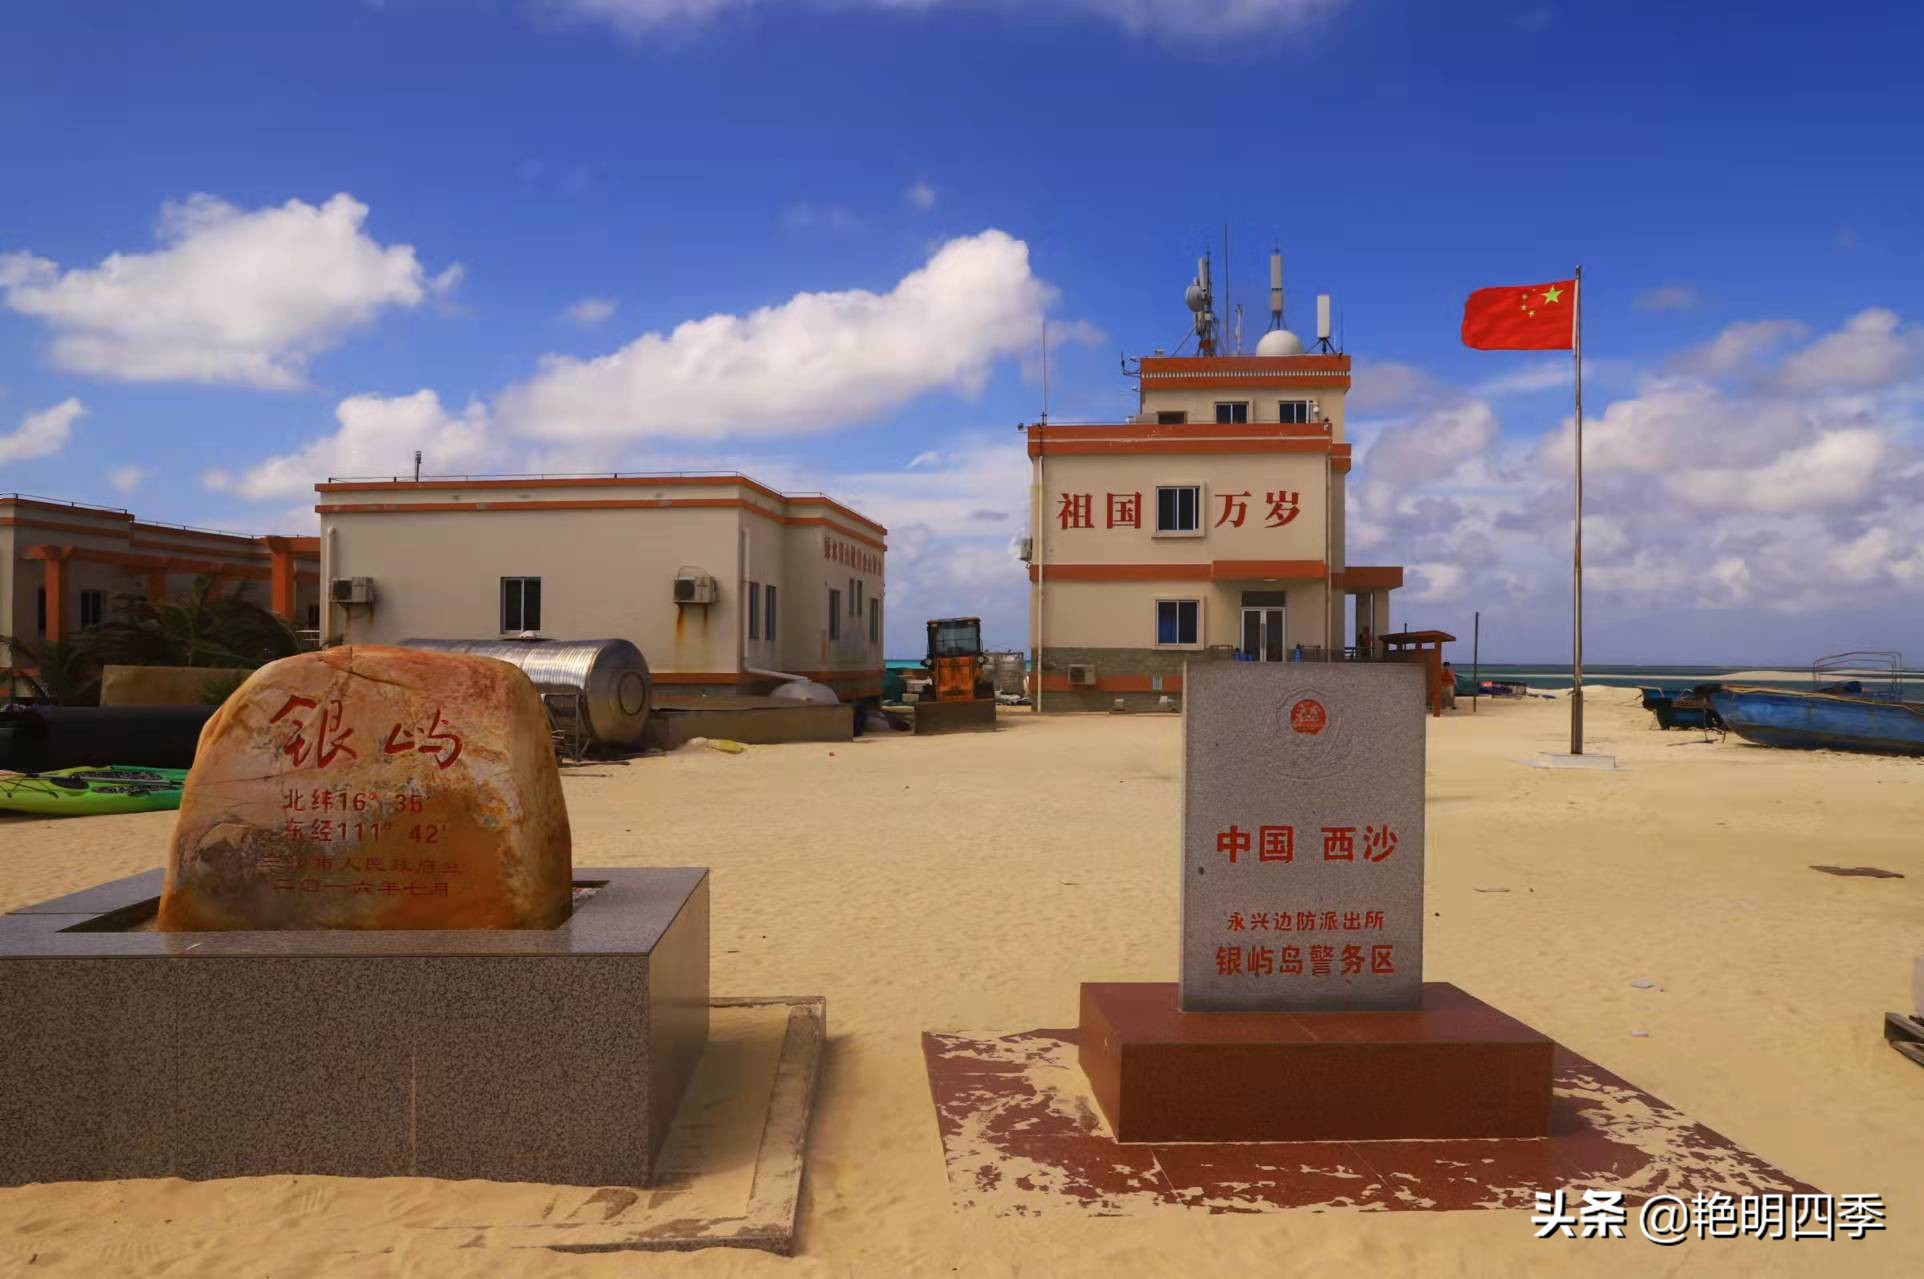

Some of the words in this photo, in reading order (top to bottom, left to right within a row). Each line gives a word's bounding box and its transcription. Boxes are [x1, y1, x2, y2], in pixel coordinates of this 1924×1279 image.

[1056, 491, 1142, 530] 祖国
[1214, 490, 1301, 529] 万岁
[269, 694, 464, 770] 银屿
[1216, 824, 1295, 863] 中国
[1320, 824, 1399, 863] 西沙
[1226, 911, 1385, 932] 永兴边防派出所
[1215, 944, 1394, 977] 银屿岛警务区
